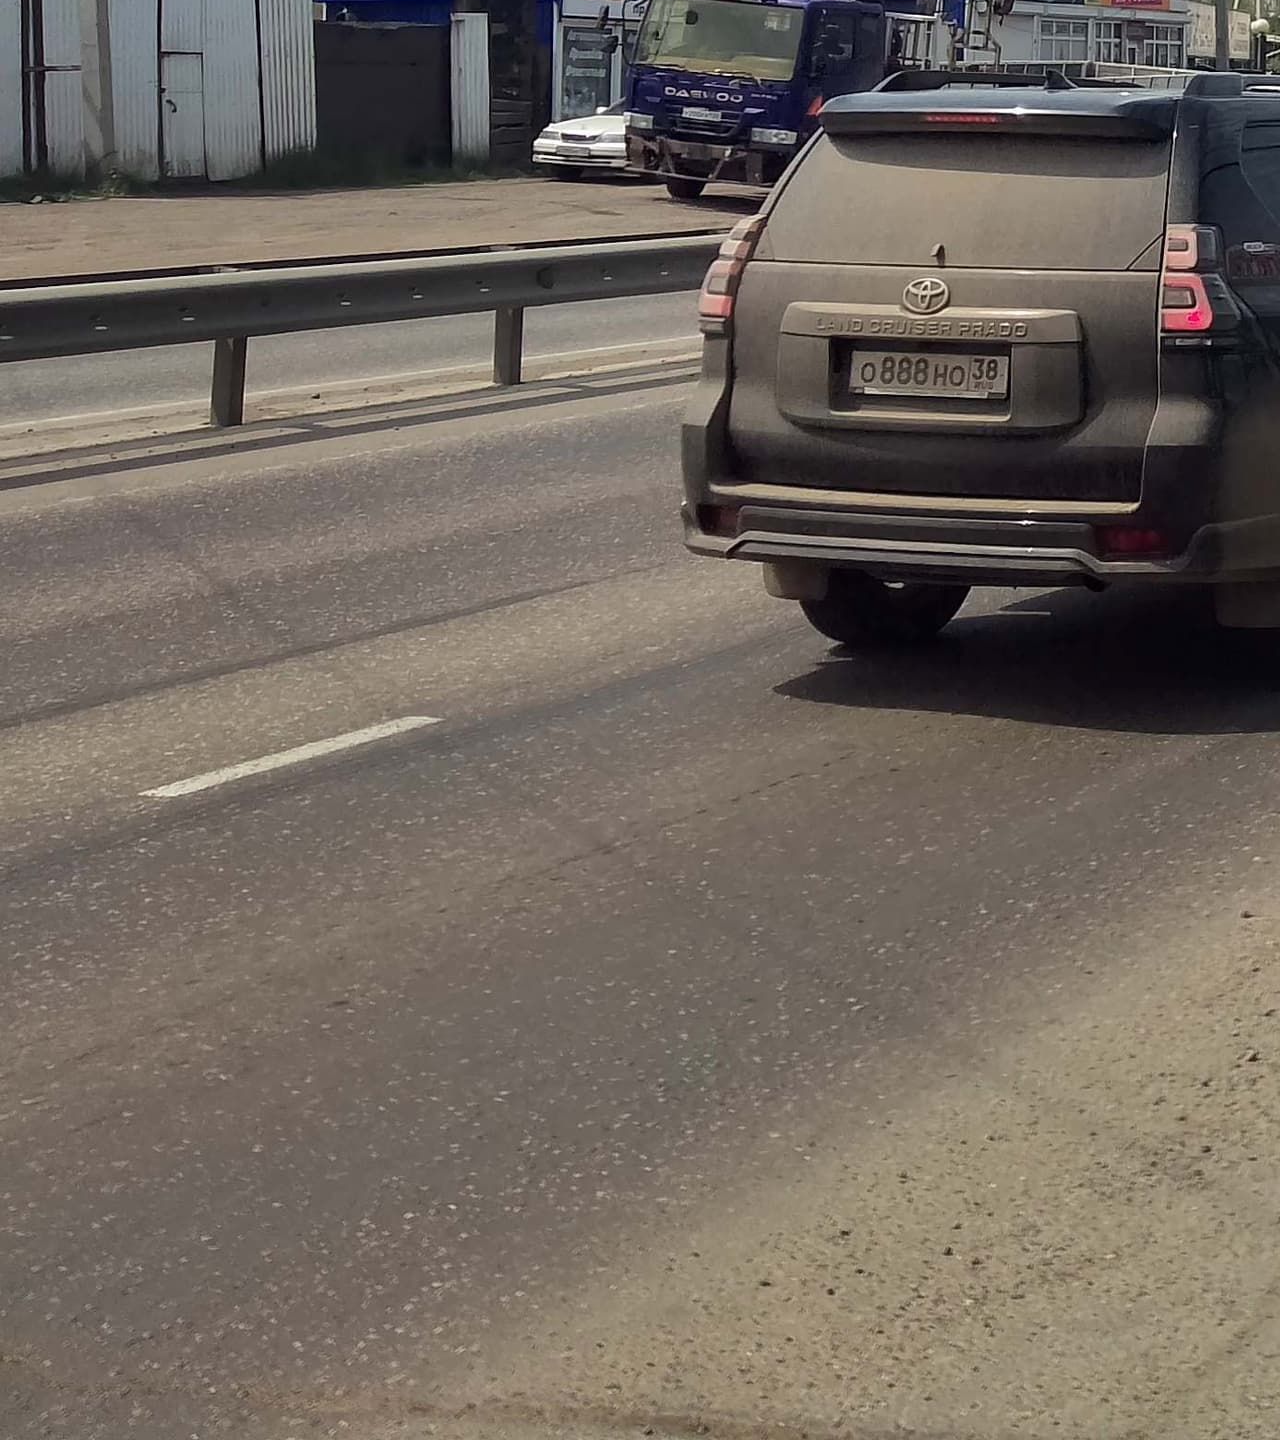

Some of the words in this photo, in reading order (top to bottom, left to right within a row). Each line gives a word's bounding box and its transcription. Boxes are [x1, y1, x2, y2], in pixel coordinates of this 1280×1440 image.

[816, 318, 863, 333] LAND
[870, 319, 951, 336] CRUISER
[959, 322, 1028, 338] PRADO
[972, 358, 998, 381] 38
